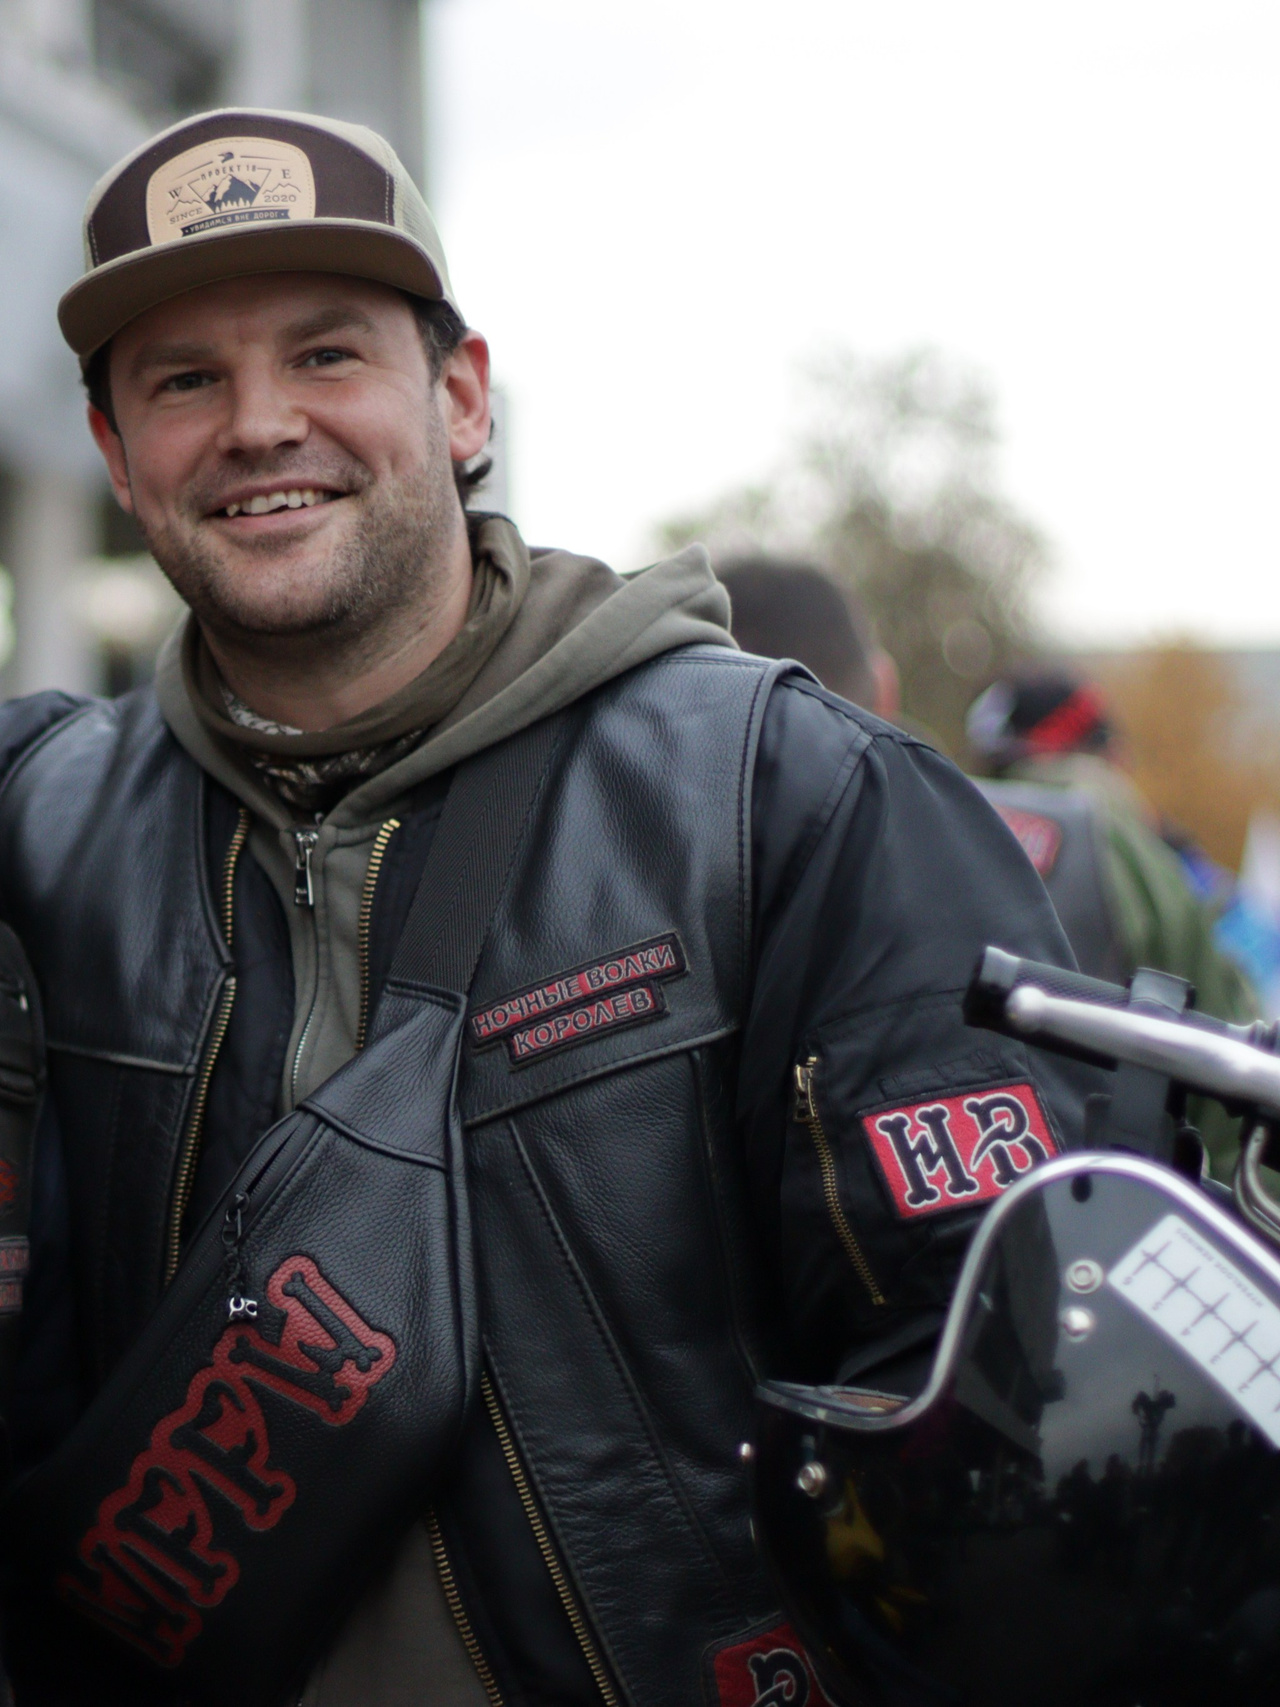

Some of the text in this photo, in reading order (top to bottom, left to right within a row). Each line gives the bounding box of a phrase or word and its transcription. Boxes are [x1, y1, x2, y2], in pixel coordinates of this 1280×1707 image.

[201, 164, 257, 180] ПРОЕКТ 18
[281, 168, 292, 179] E
[168, 186, 184, 200] W
[169, 194, 297, 225] SINCE 2020
[190, 211, 279, 233] УВИДИМСЯ ВНЕ ДОРОГ
[472, 944, 676, 1037] НОЧНЫЕ ВОЛКИ
[513, 987, 652, 1056] КОРОЛЕВ
